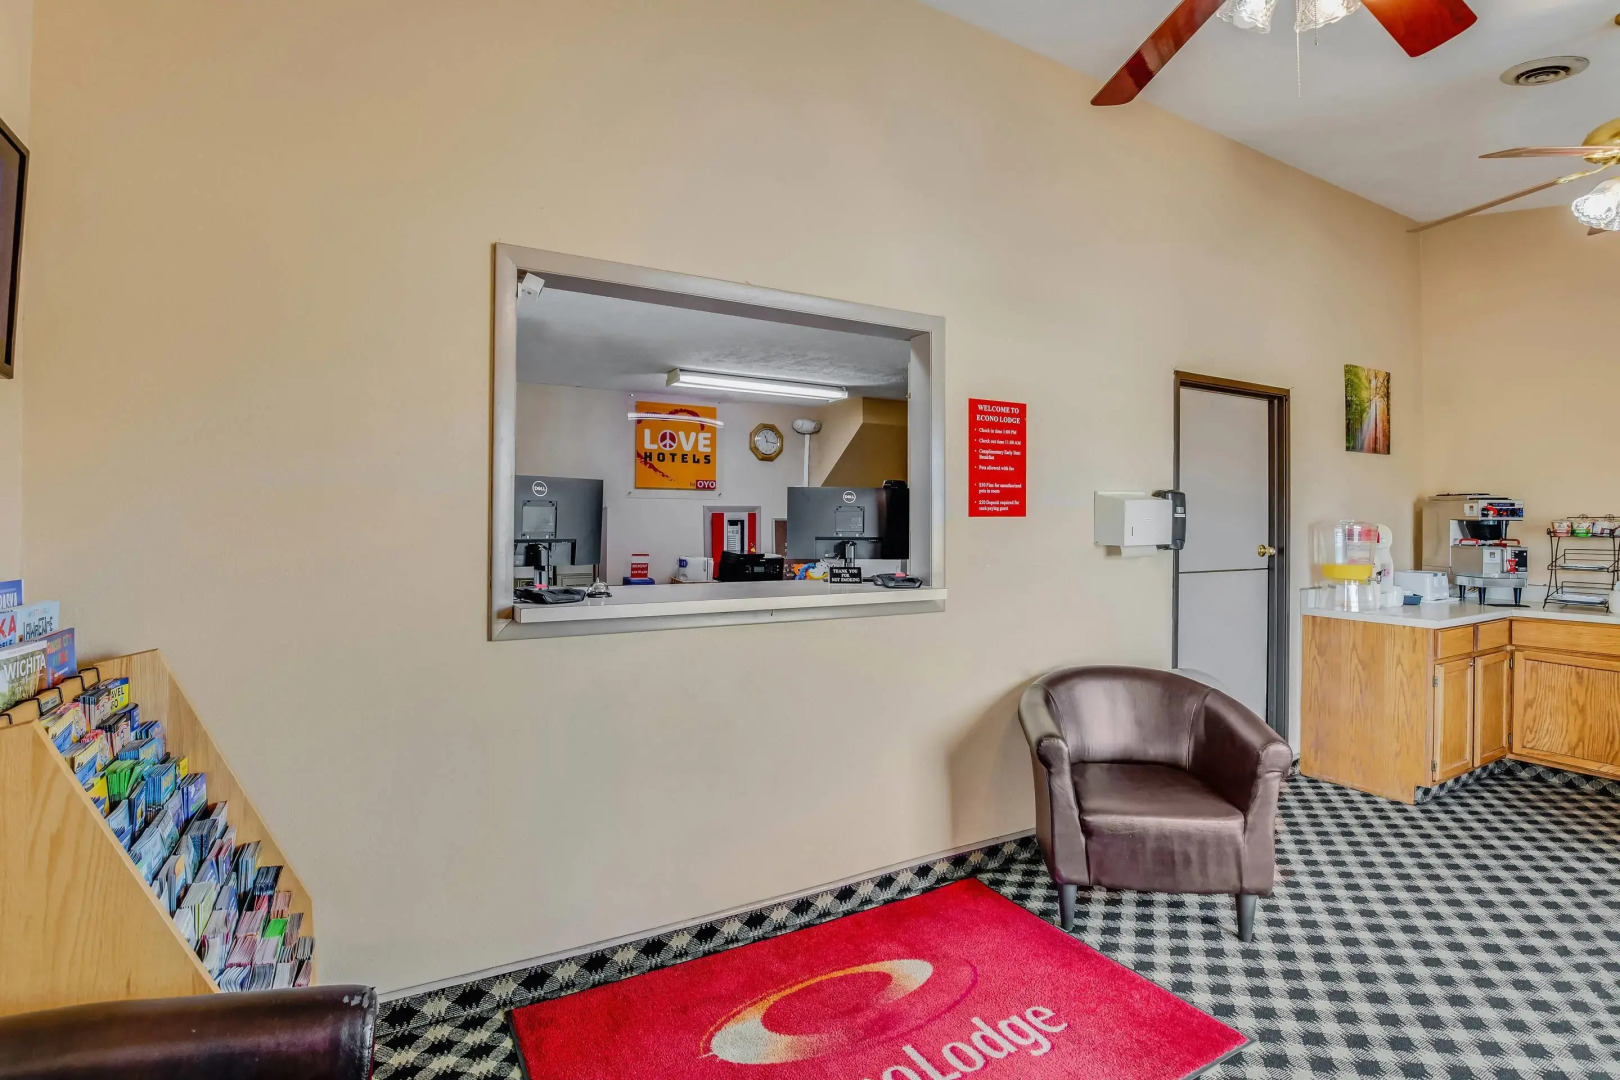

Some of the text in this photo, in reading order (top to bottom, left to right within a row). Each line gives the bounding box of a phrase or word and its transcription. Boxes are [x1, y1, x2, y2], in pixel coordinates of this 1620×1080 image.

[978, 404, 1010, 413] WELCOME
[976, 414, 1020, 424] ECONO LODGE
[644, 429, 712, 452] LOVE
[643, 452, 711, 465] HOTELS
[697, 480, 716, 488] OYO
[4, 653, 47, 680] WICHITA
